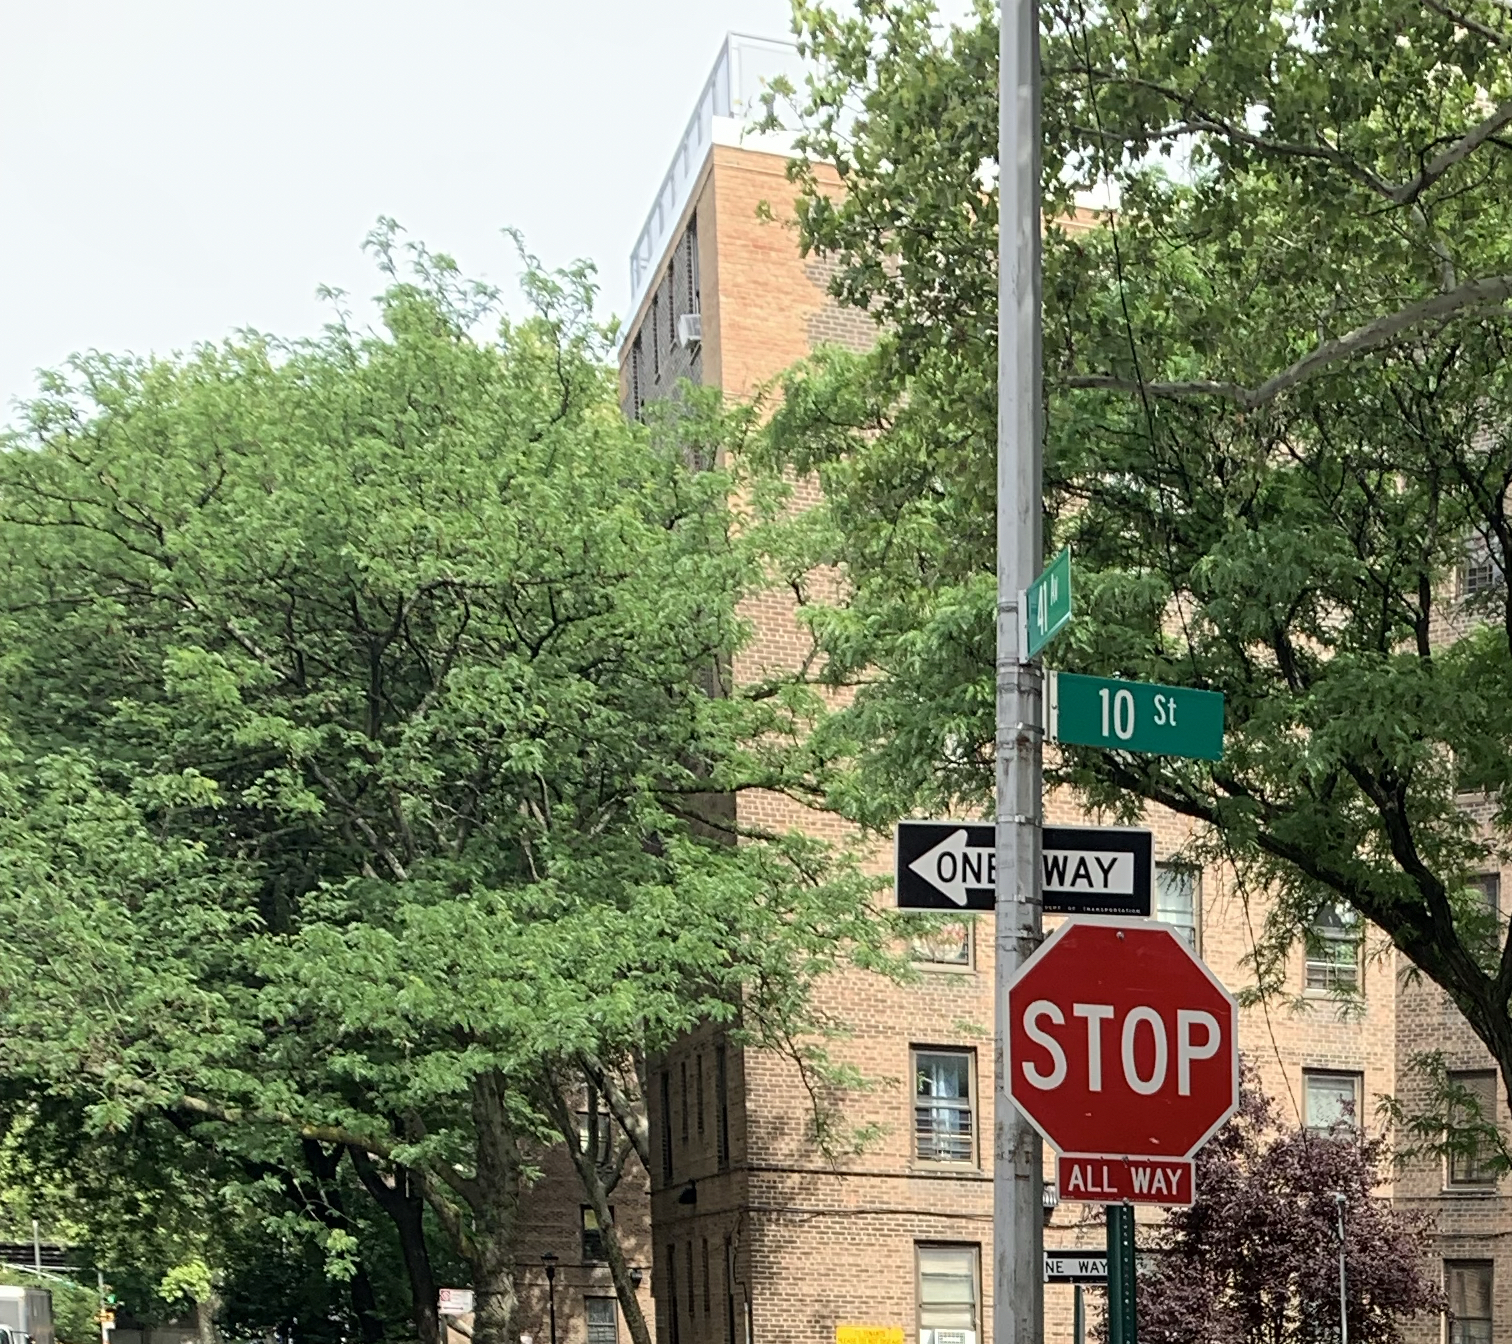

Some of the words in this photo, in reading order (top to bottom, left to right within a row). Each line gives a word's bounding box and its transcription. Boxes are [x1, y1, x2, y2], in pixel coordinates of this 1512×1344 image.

[1099, 688, 1135, 740] 10
[1153, 694, 1177, 727] St
[936, 851, 996, 885] ONE
[1042, 854, 1119, 889] WAY
[1021, 999, 1222, 1097] STOP
[1067, 1164, 1118, 1194] ALL
[1131, 1167, 1184, 1196] WAY
[1045, 1260, 1064, 1274] NE
[1078, 1260, 1108, 1274] WAY
